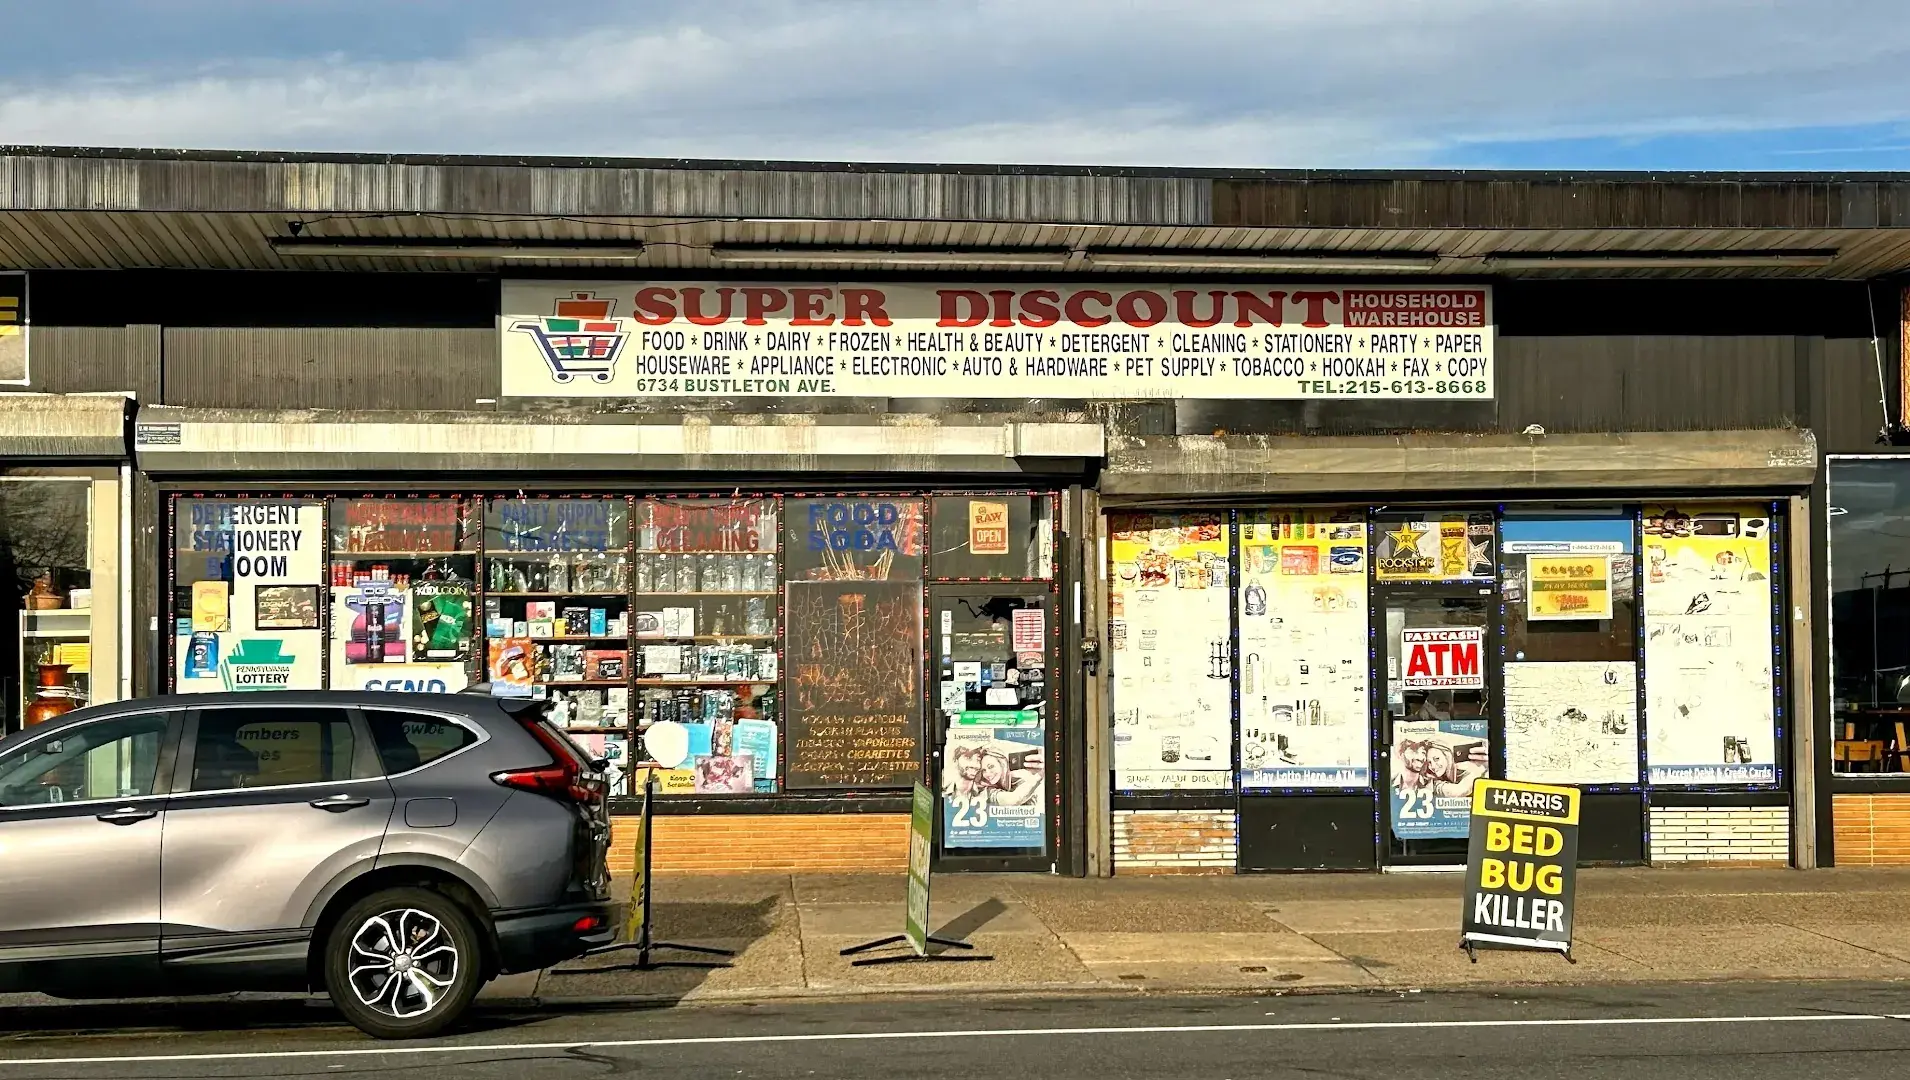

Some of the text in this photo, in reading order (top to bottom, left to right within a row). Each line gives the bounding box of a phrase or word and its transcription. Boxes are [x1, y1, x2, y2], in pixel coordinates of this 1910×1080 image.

[633, 287, 1341, 328] SUPER DISCOUNT
[1350, 294, 1477, 308] HOUSEHOLD
[1349, 311, 1481, 326] WAREHOUSE
[643, 331, 1481, 353] FOOD DRINK DAIRY FROZEN HEALTH & BEAUTY DETERGENT CLEANING STATIONERY PARTY PAPER
[637, 356, 1486, 376] HOUSEWARE APPLIANCE ELECTRONIC AUTO & HARDWARE PET SUPPLY TOBACCO HOOKAH FAX COPY
[637, 379, 836, 392] 6734 BUSTLETON AVE.
[1298, 380, 1487, 393] TEL:215-613-8668
[192, 504, 302, 525] DETERGENT
[557, 502, 609, 525] SUPPLY
[808, 503, 898, 526] FOOD
[975, 512, 1002, 523] RAW
[193, 530, 302, 552] STATIONERY
[808, 530, 899, 550] SODA
[977, 530, 1002, 543] OPEN
[1407, 643, 1478, 676] ATM
[236, 674, 290, 684] LOTTERY
[847, 749, 911, 759] CIGARETTES
[1253, 770, 1273, 784] Play
[1277, 770, 1301, 781] Lotto
[1335, 769, 1356, 781] ATM
[1494, 789, 1563, 811] HARRIS
[991, 807, 1035, 816] Unlimited
[1486, 821, 1563, 857] BED
[1481, 858, 1562, 895] BUG
[1474, 893, 1564, 932] KILLER
